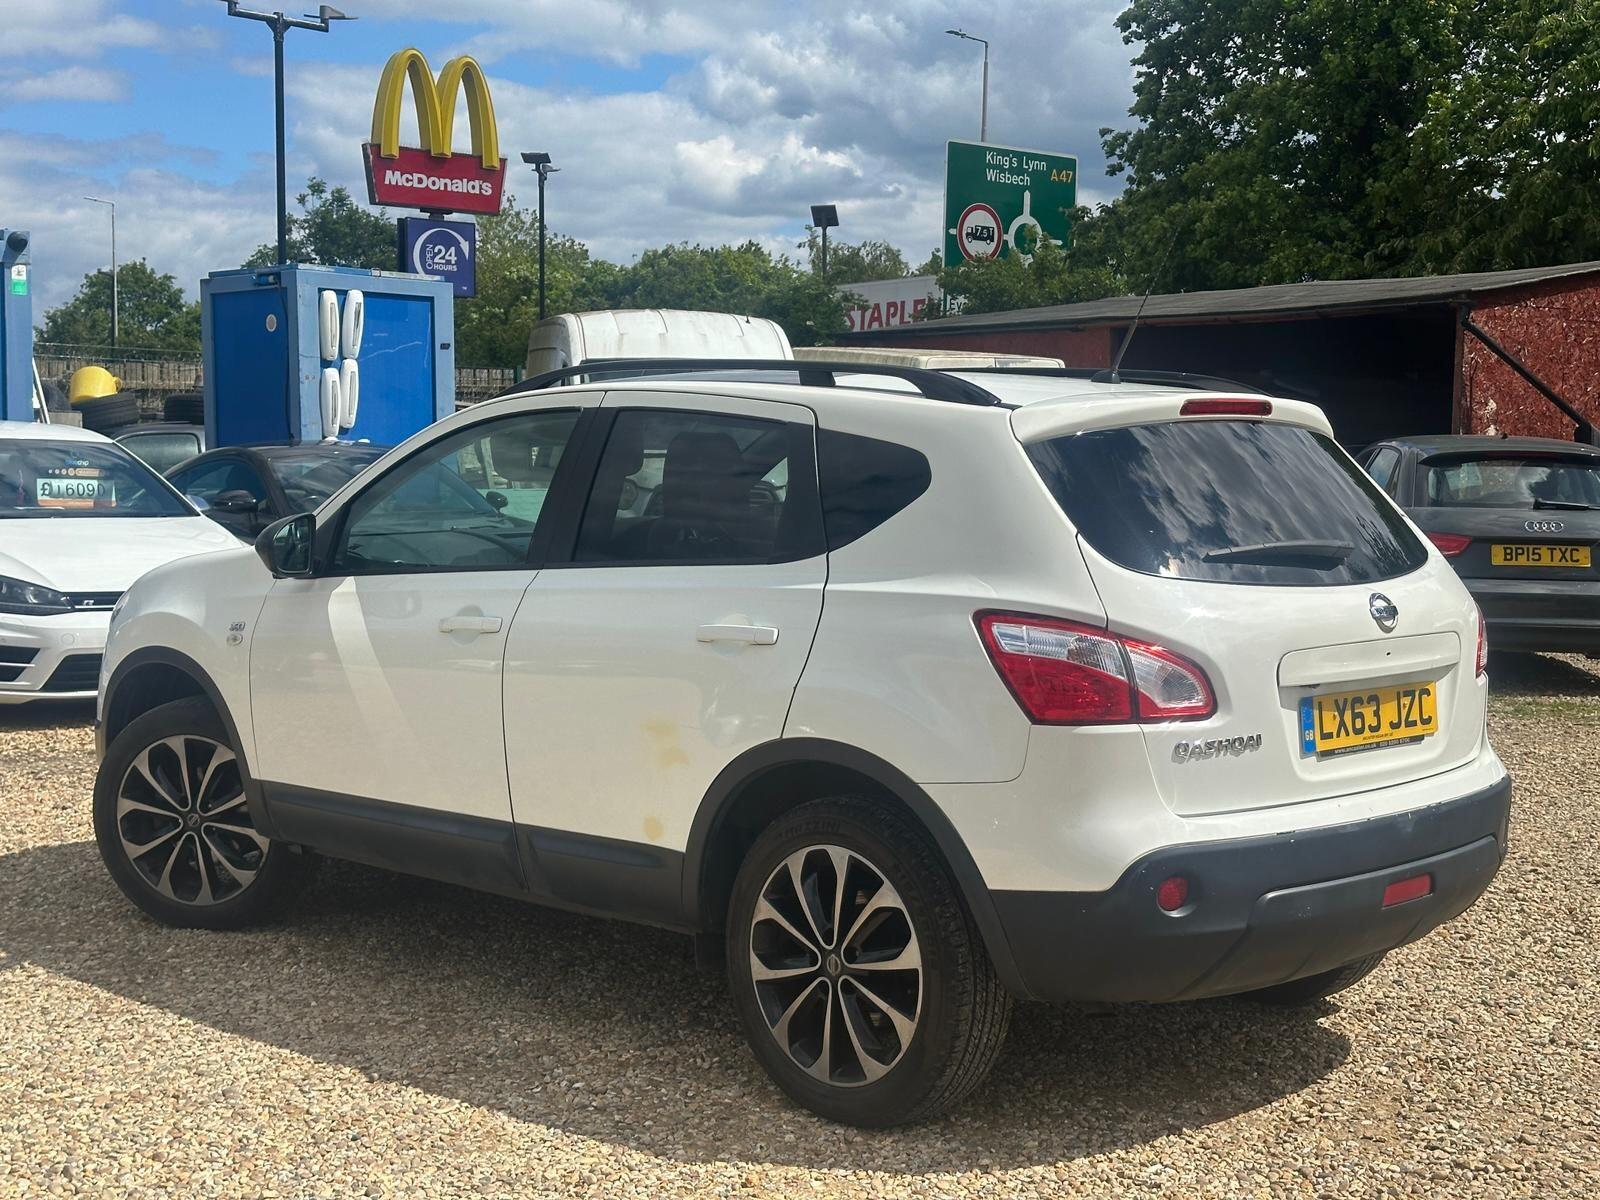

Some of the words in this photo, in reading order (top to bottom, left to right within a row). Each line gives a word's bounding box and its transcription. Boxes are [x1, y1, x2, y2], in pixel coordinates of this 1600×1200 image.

[986, 151, 1018, 169] King's
[1023, 156, 1047, 172] Lynn
[384, 170, 493, 196] McDonald's
[986, 168, 1031, 186] Wisbech
[1050, 168, 1073, 183] A47
[425, 244, 434, 270] OPEN
[433, 245, 458, 264] 24
[433, 263, 458, 272] HOURS
[845, 298, 928, 331] STAPLE
[1503, 546, 1541, 562] BP15
[1547, 547, 1580, 563] TXC
[1317, 693, 1381, 741] LX63
[1388, 687, 1433, 730] JZC
[1304, 730, 1314, 742] GB
[1173, 733, 1263, 763] QASHQAI
